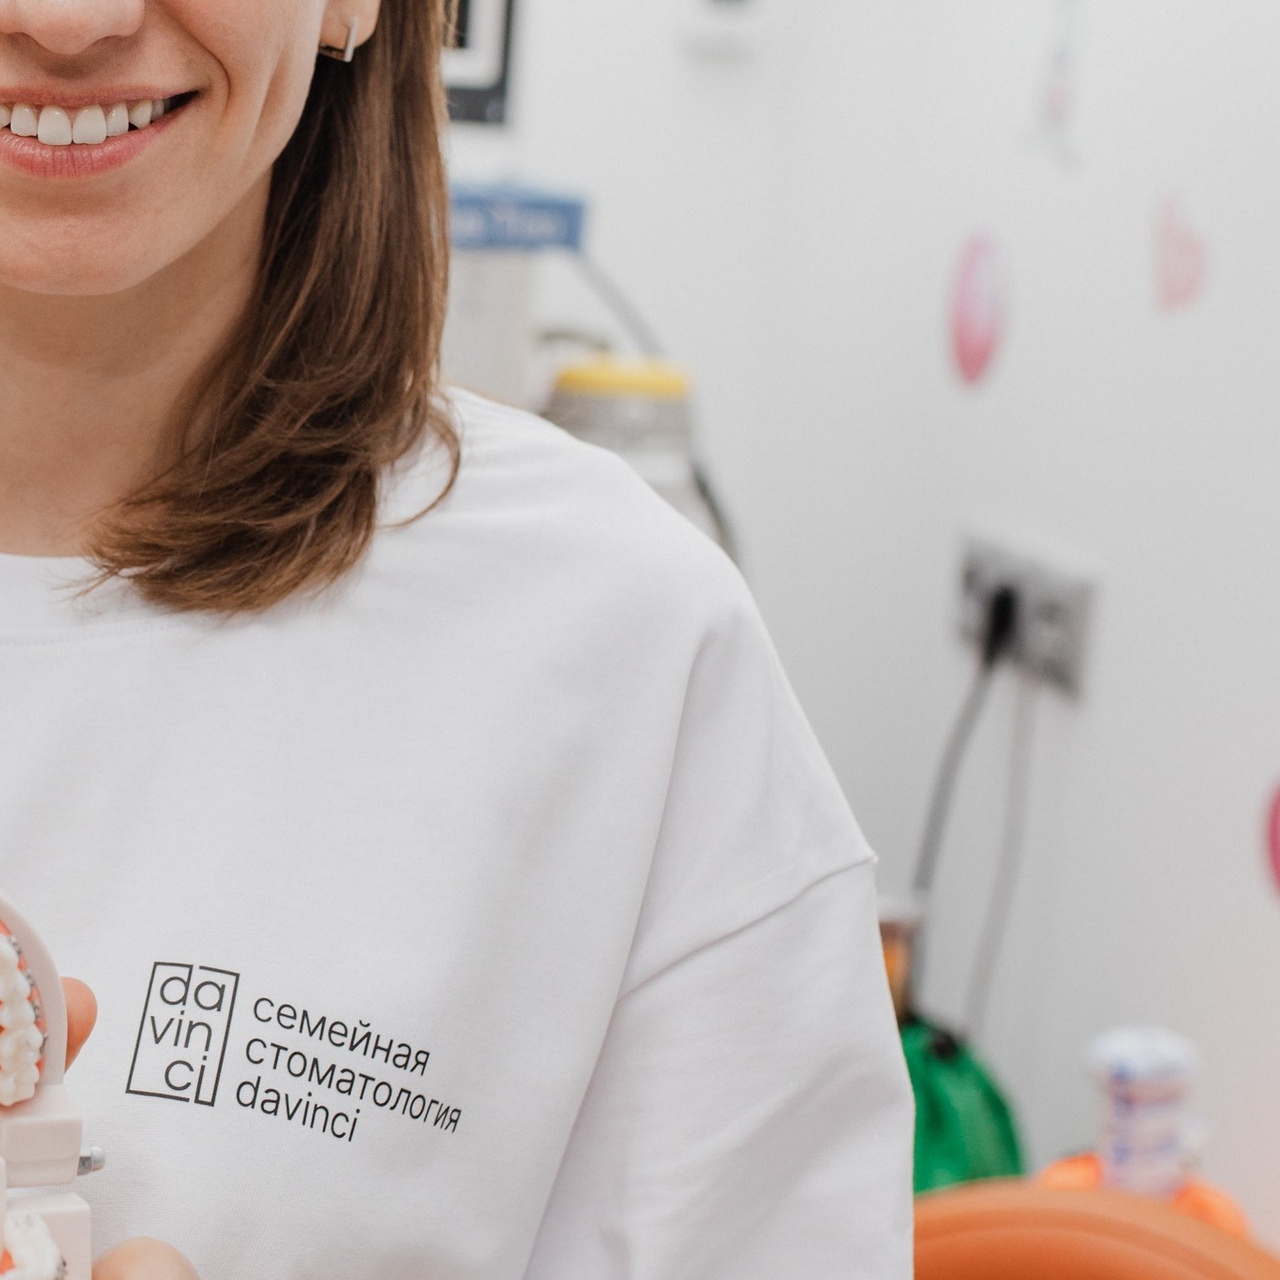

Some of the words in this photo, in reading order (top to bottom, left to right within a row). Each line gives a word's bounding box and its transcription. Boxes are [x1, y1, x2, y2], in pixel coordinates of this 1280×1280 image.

[159, 965, 226, 1012] da
[150, 1010, 213, 1052] vin
[253, 997, 431, 1076] семейная
[164, 1054, 209, 1103] ci
[246, 1038, 462, 1134] стоматология
[236, 1075, 361, 1143] davinci
